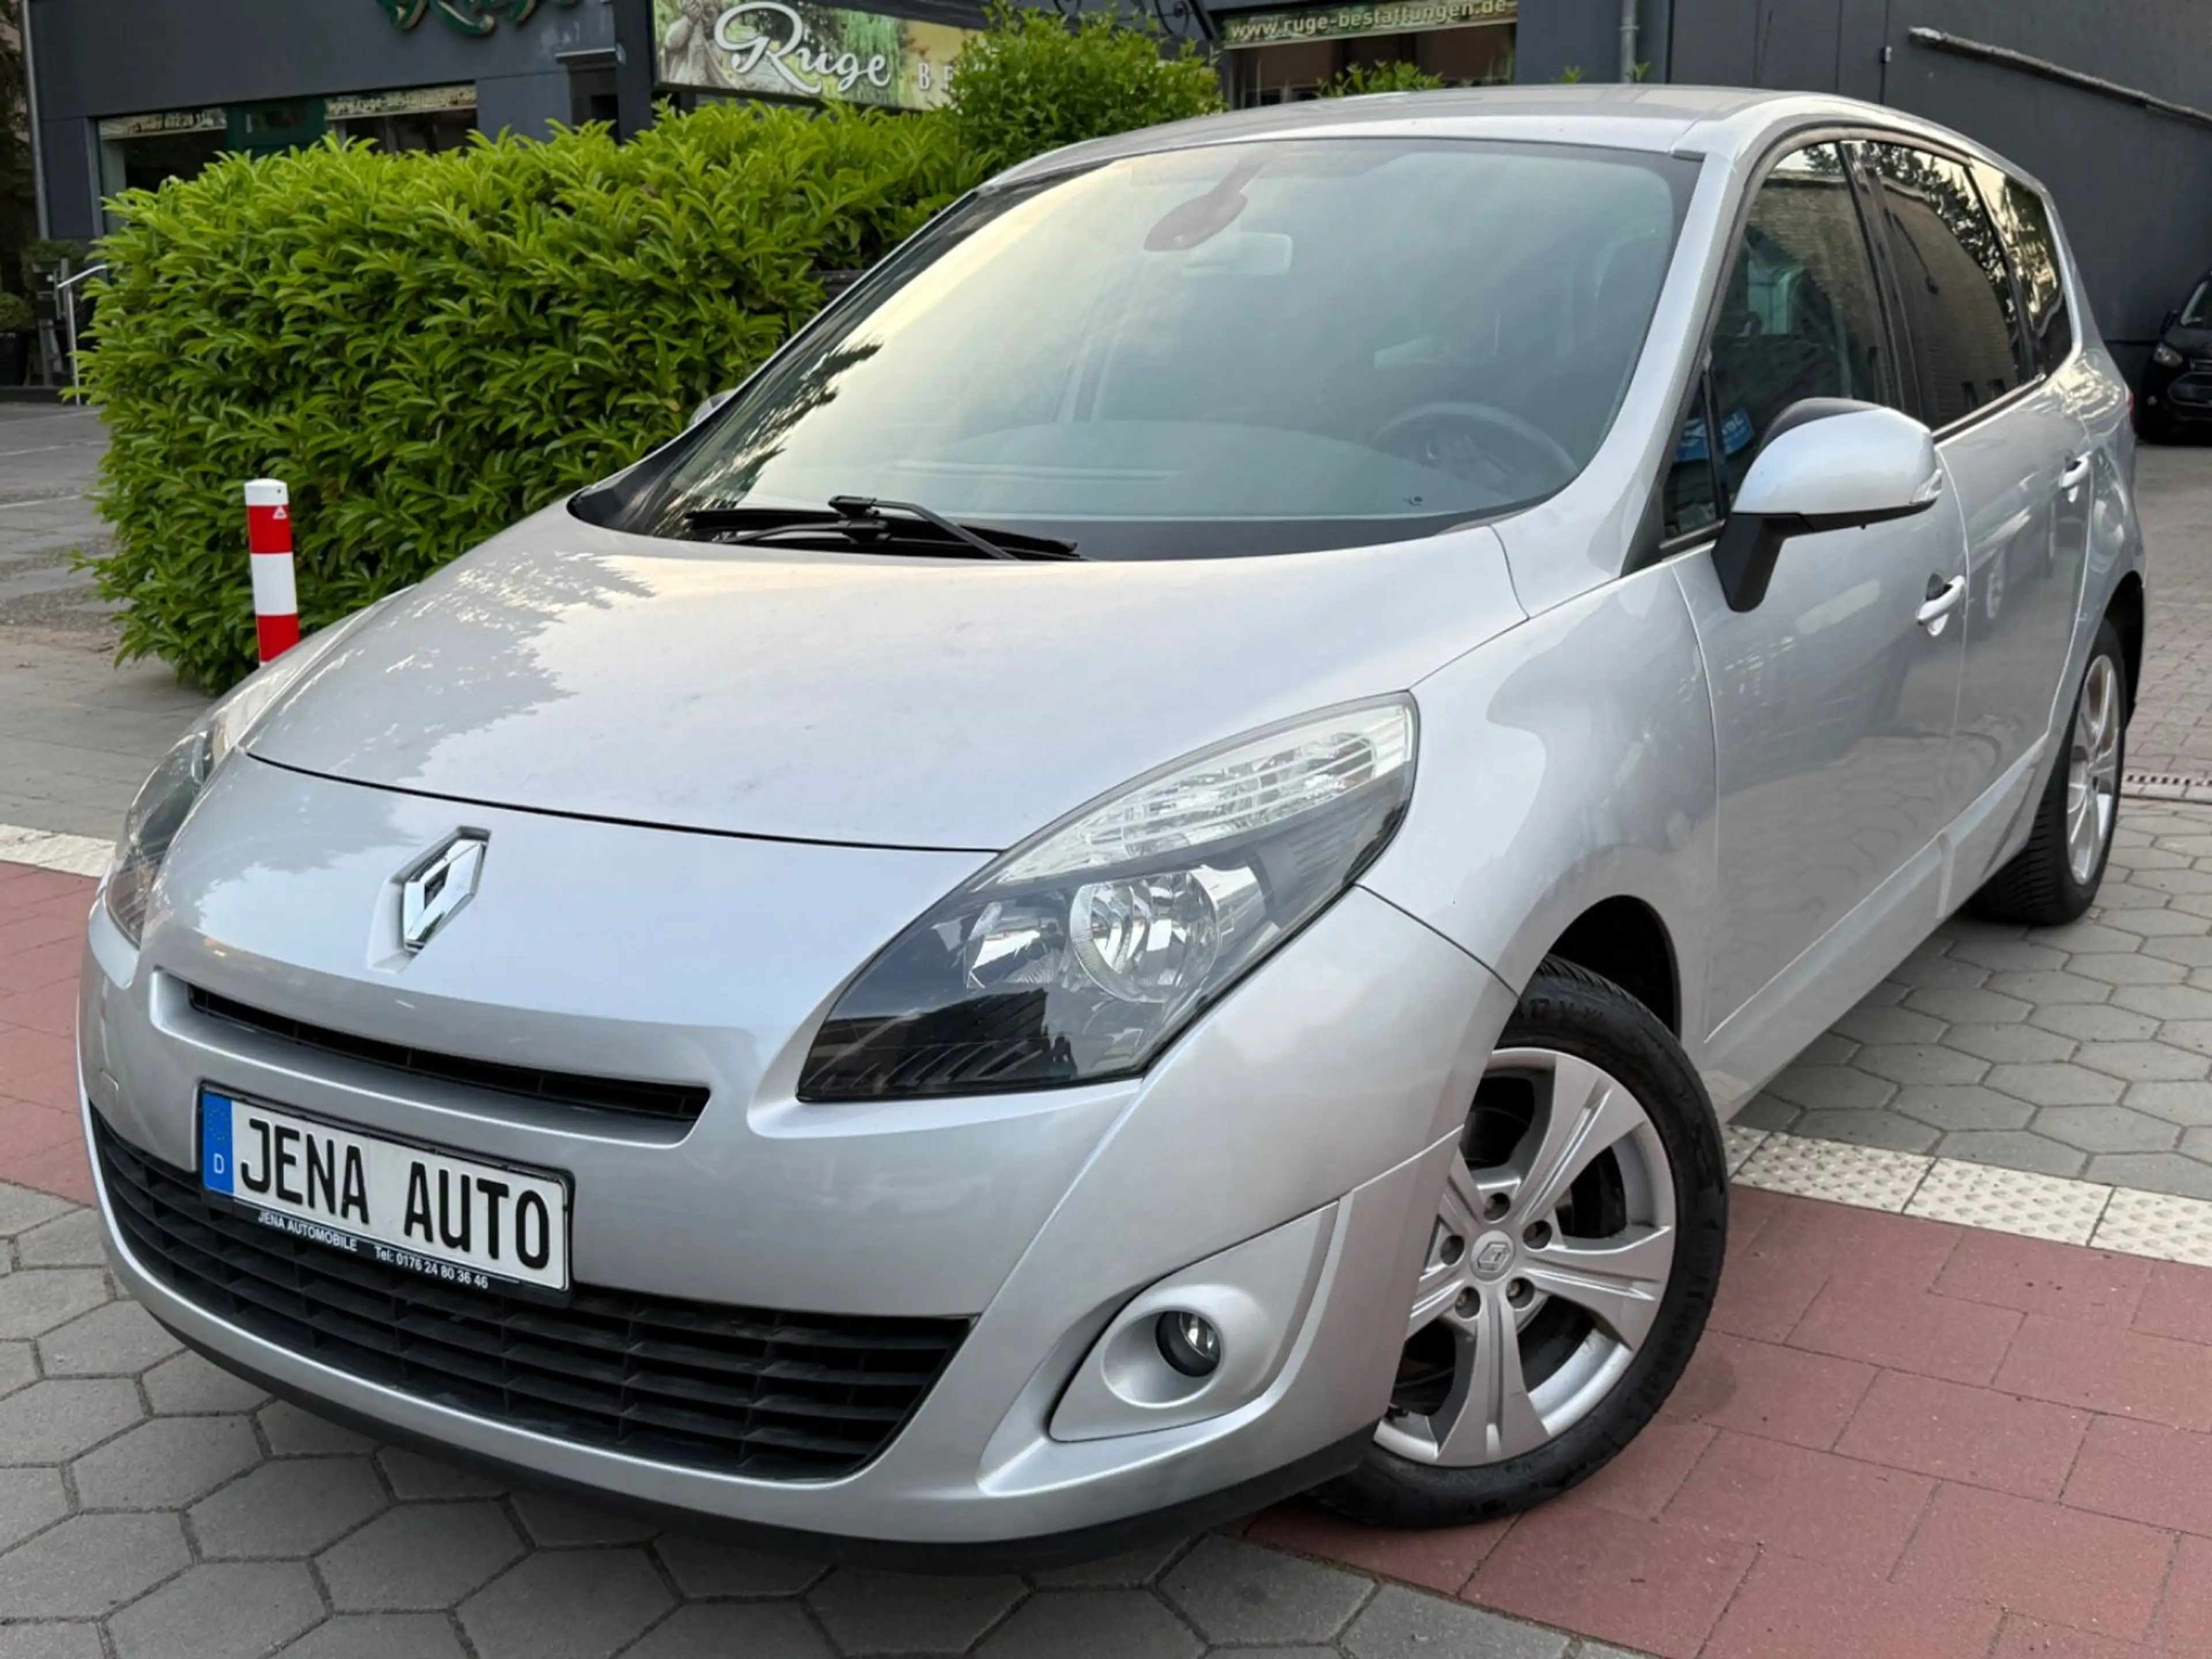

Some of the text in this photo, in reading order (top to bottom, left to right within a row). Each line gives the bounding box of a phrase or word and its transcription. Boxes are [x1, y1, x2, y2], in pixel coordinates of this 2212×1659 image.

[715, 2, 891, 93] Ruge
[213, 1153, 225, 1175] D
[240, 1118, 550, 1270] JENA AUTO
[258, 1210, 358, 1252] JENA AUTOMOBILE
[424, 1261, 438, 1275] 24
[457, 1270, 472, 1285] 36
